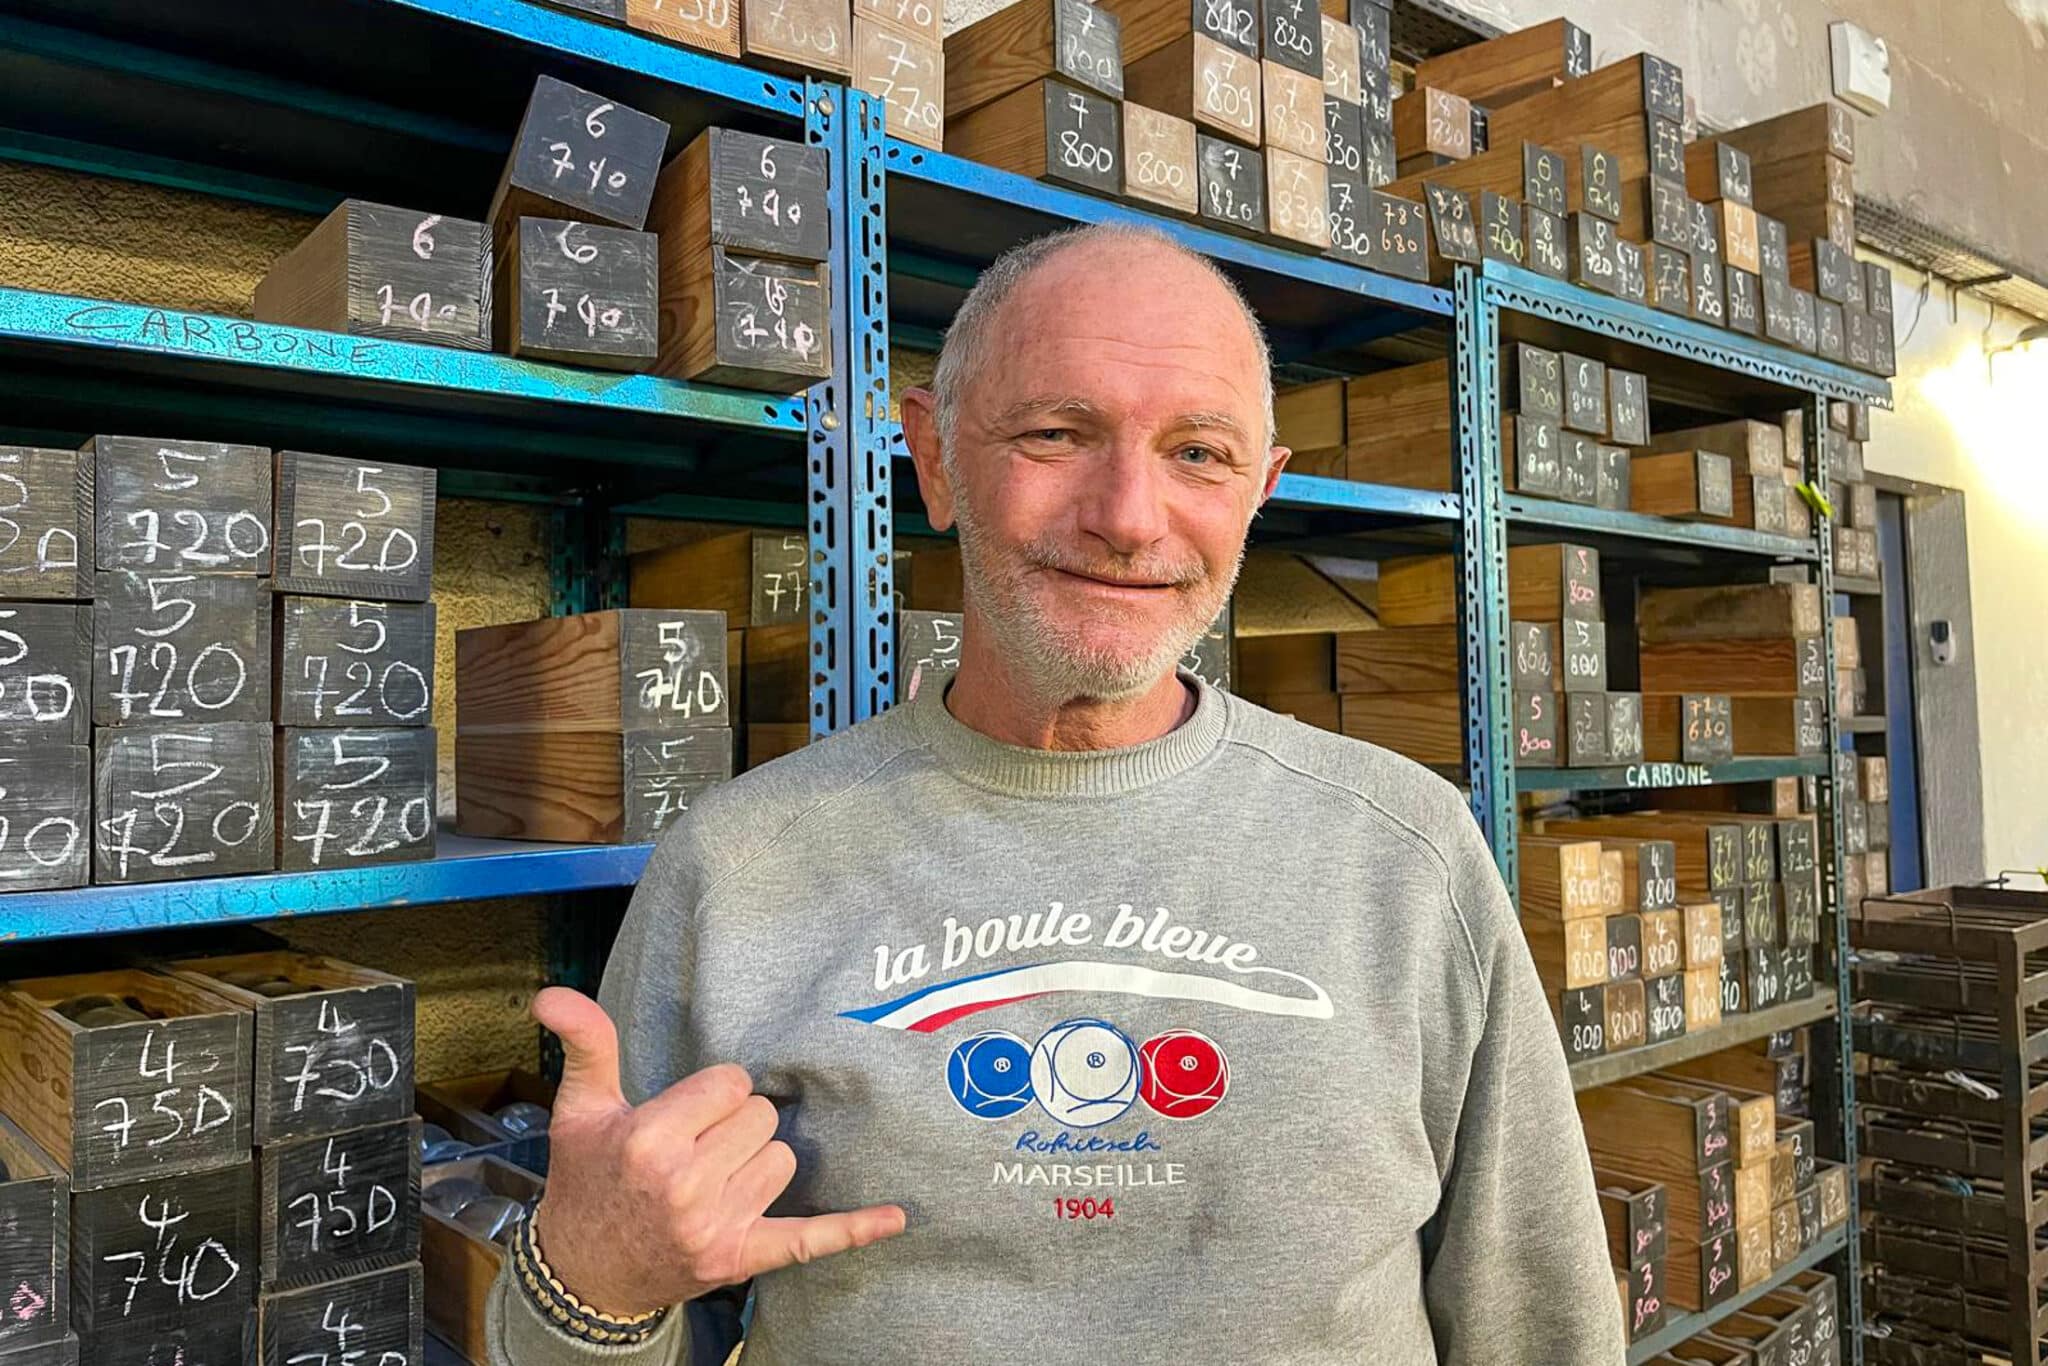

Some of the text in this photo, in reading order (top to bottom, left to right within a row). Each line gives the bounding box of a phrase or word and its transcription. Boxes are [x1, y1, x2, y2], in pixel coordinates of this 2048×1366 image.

[1077, 6, 1096, 35] 7
[1274, 16, 1313, 56] 820
[878, 32, 917, 77] 7
[1066, 36, 1112, 79] 800
[1216, 47, 1239, 80] 7
[1068, 92, 1089, 129] 7
[1204, 68, 1255, 127] 809
[587, 103, 615, 138] 6
[760, 145, 777, 180] 6
[1060, 131, 1114, 173] 800
[1224, 150, 1243, 181] 7
[1136, 152, 1184, 188] 800
[1209, 183, 1253, 222] 820
[1331, 183, 1353, 212] 7
[412, 214, 441, 259] 6
[555, 221, 598, 264] 6
[1328, 212, 1371, 255] 830
[1381, 229, 1418, 254] 680
[1703, 263, 1713, 286] 8
[1696, 285, 1723, 318] 750
[64, 306, 381, 365] CARBONE
[1578, 362, 1588, 389] 6
[1625, 375, 1633, 396] 6
[1537, 425, 1548, 449] 6
[154, 448, 206, 492] 5
[357, 467, 392, 519] 5
[122, 509, 270, 564] 720
[297, 518, 419, 577] 720
[783, 535, 806, 567] 5
[135, 575, 197, 637] 5
[337, 601, 389, 654] 5
[657, 621, 688, 664] 5
[932, 618, 961, 653] 5
[1575, 619, 1590, 648] 5
[1570, 653, 1599, 677] 800
[1807, 639, 1819, 663] 5
[109, 642, 247, 720] 720
[296, 655, 430, 720] 720
[1530, 695, 1542, 721] 5
[1519, 728, 1552, 757] 800
[131, 734, 226, 799] 5
[320, 733, 392, 790] 5
[1626, 762, 1712, 788] CARBONE
[292, 796, 432, 866] 720
[1644, 876, 1676, 908] 800
[872, 901, 1258, 992] la boule bleue
[1579, 923, 1593, 948] 4
[1655, 916, 1668, 942] 4
[1572, 949, 1605, 979] 800
[1608, 944, 1638, 979] 800
[1648, 937, 1679, 974] 800
[1759, 948, 1770, 974] 4
[1579, 989, 1592, 1015] 4
[1756, 971, 1779, 1007] 810
[318, 999, 357, 1038] 4
[1610, 1008, 1643, 1044] 800
[139, 1029, 183, 1083] 4
[1572, 1023, 1604, 1054] 800
[1706, 1102, 1716, 1129] 3
[323, 1137, 353, 1188] 4
[1704, 1133, 1729, 1157] 800
[991, 1162, 1187, 1187] MARSEILLE
[139, 1193, 190, 1249] 4
[1053, 1196, 1116, 1220] 1904
[1644, 1193, 1655, 1219] 3
[1713, 1237, 1722, 1263] 3
[1641, 1261, 1653, 1296] 3
[322, 1301, 365, 1351] 4
[1633, 1296, 1660, 1333] 800
